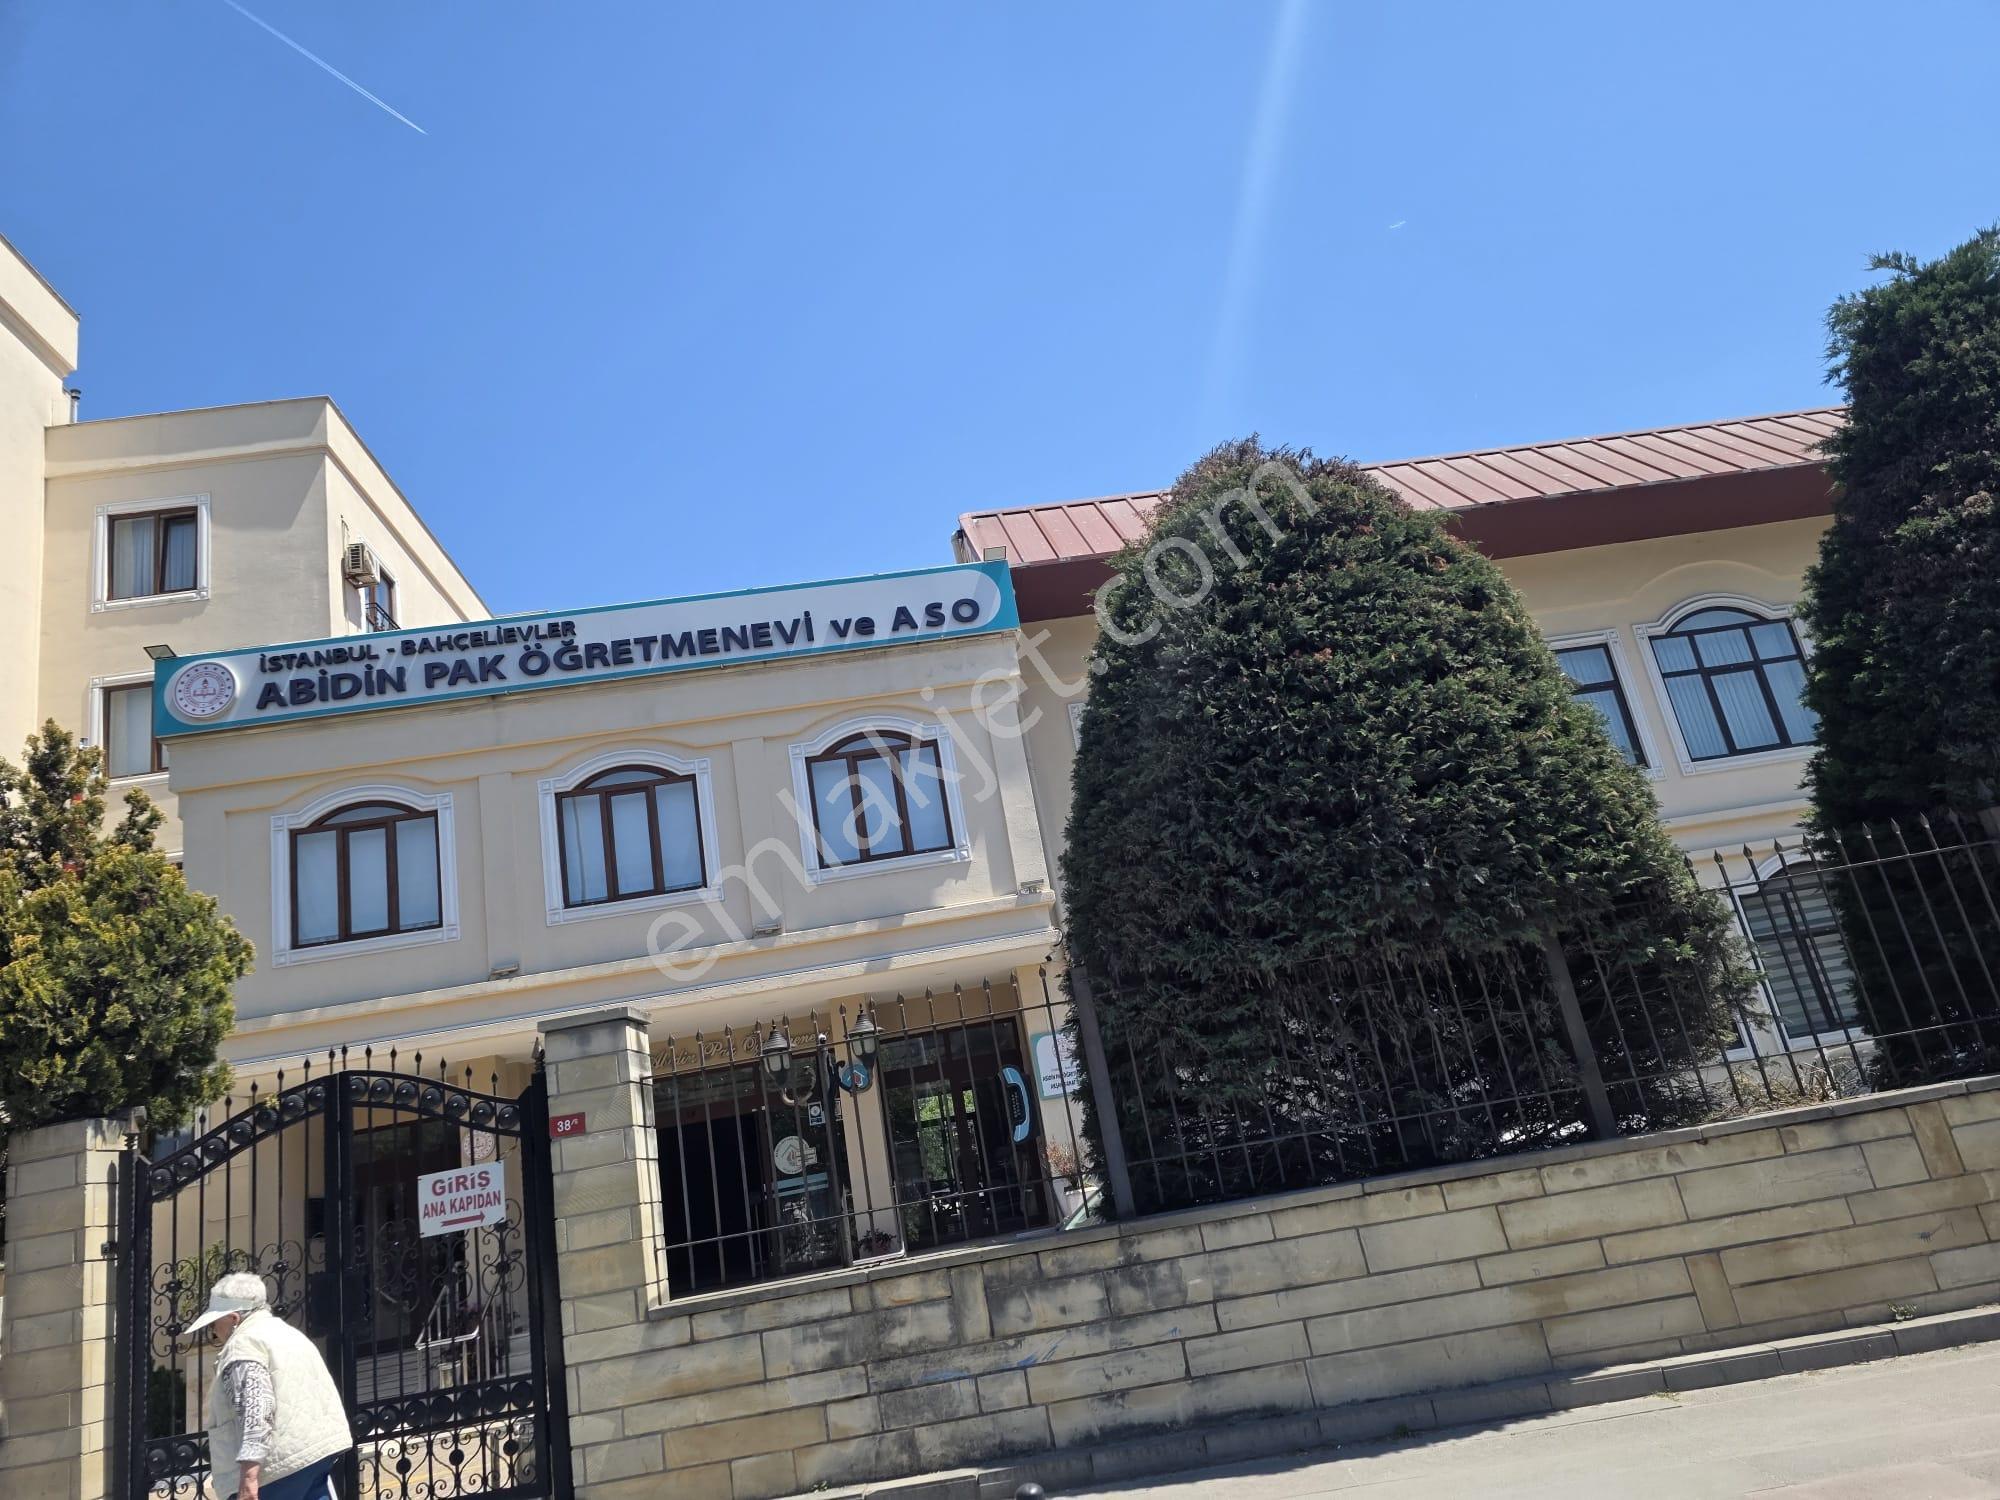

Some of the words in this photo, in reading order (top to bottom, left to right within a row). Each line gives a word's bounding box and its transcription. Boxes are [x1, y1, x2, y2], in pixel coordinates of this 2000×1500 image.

[256, 663, 407, 710] ABİDİN
[424, 654, 507, 689] PAK
[518, 610, 815, 676] ÖĞRETMENEVİ
[829, 616, 875, 638] ve
[892, 598, 980, 632] ASO
[259, 644, 379, 673] İSTANBUL
[400, 620, 577, 656] BAHÇELİEVLER
[423, 1200, 446, 1220] ANA
[449, 1189, 502, 1215] KAPIDAN
